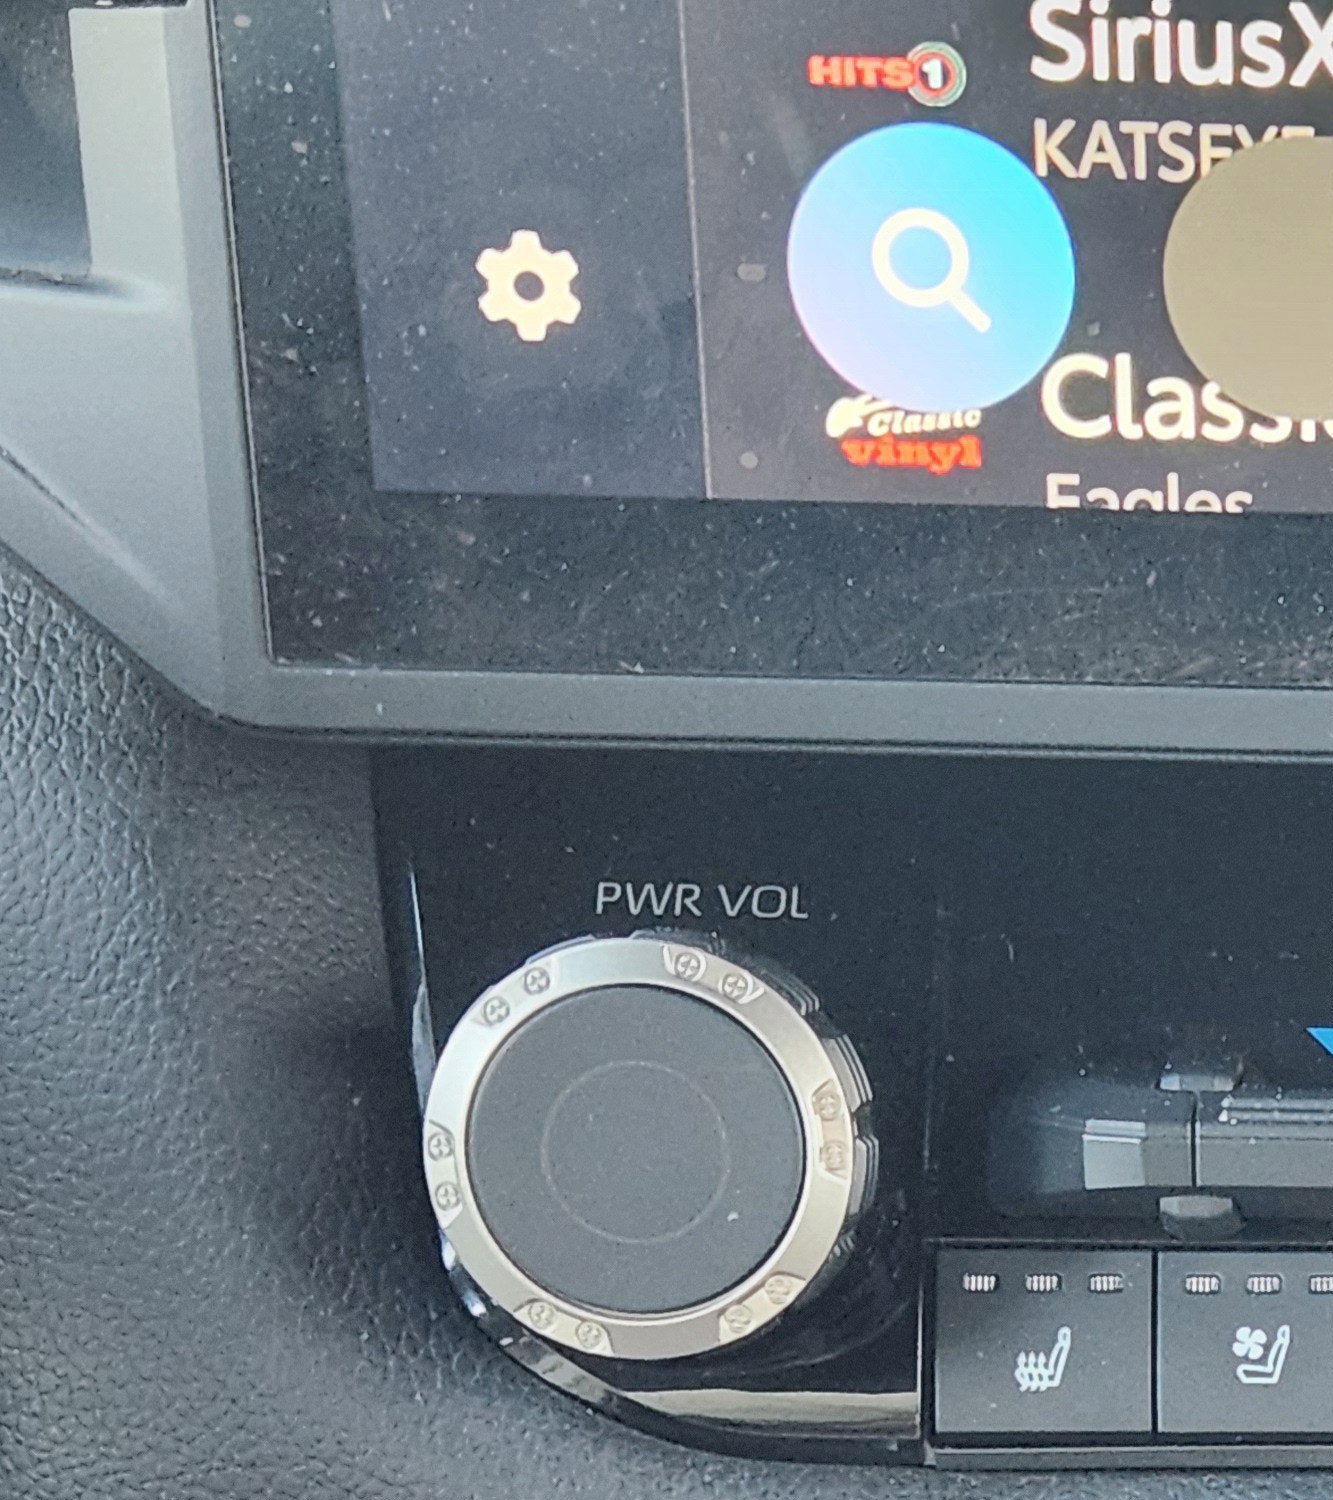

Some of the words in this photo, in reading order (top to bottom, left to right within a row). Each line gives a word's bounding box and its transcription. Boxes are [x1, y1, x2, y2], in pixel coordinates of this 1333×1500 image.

[807, 55, 915, 90] HITS
[1033, 117, 1316, 182] KATSE
[841, 433, 982, 475] vinyl
[595, 881, 703, 917] PWR
[717, 884, 809, 919] VOL
